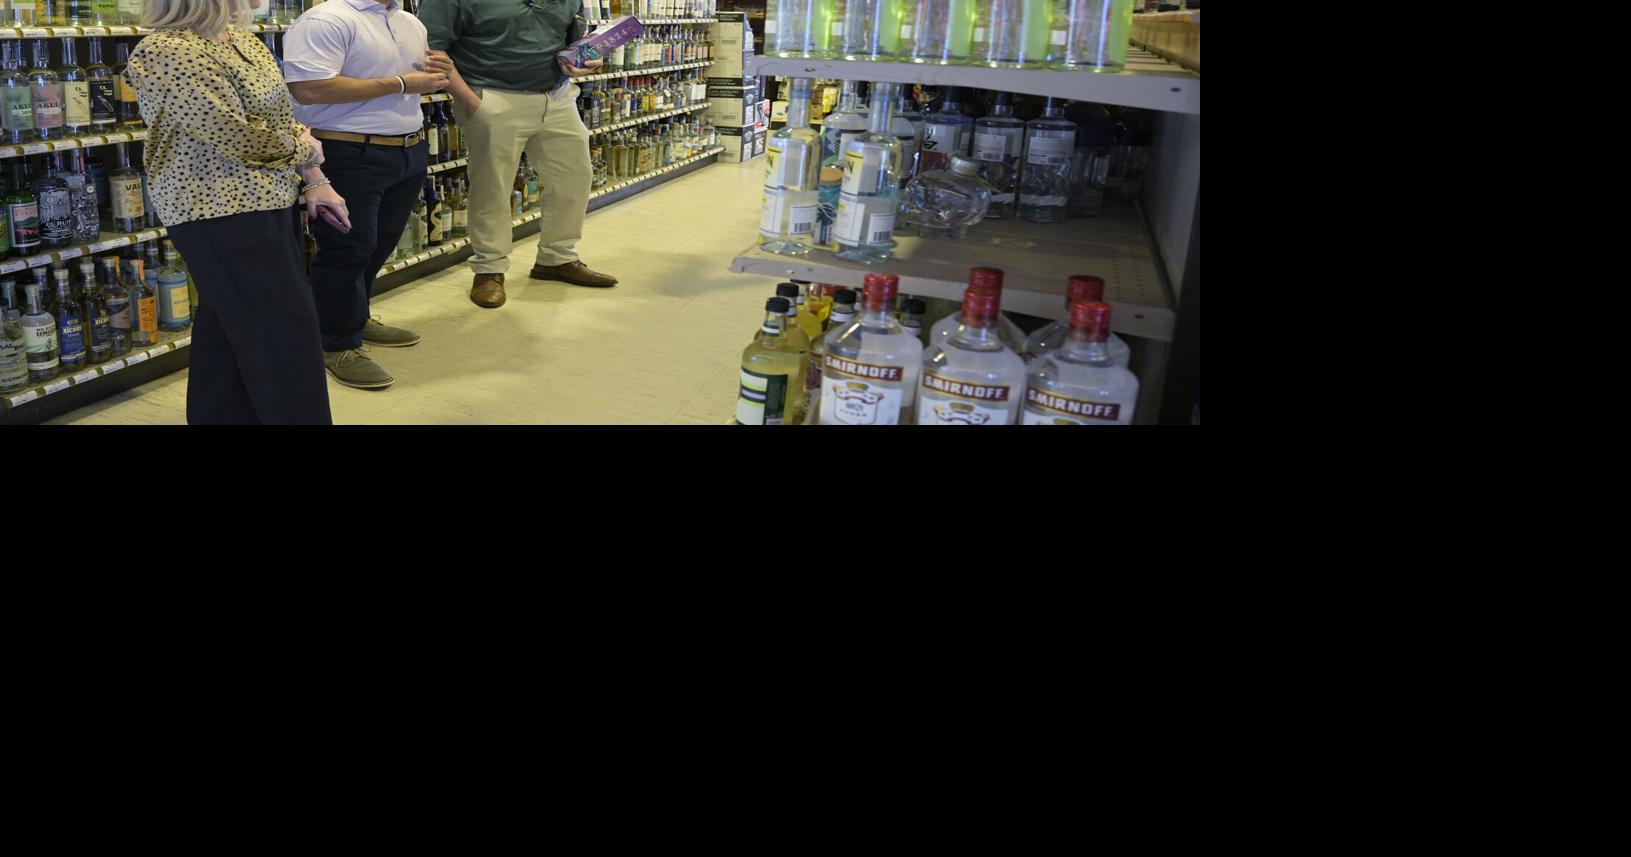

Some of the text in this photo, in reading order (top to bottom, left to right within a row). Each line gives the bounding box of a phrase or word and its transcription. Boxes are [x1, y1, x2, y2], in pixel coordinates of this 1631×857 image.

[825, 356, 898, 379] SMIRNOFF
[924, 375, 1005, 399] SMIRNOFF
[1027, 389, 1114, 417] SMIRNOFF
